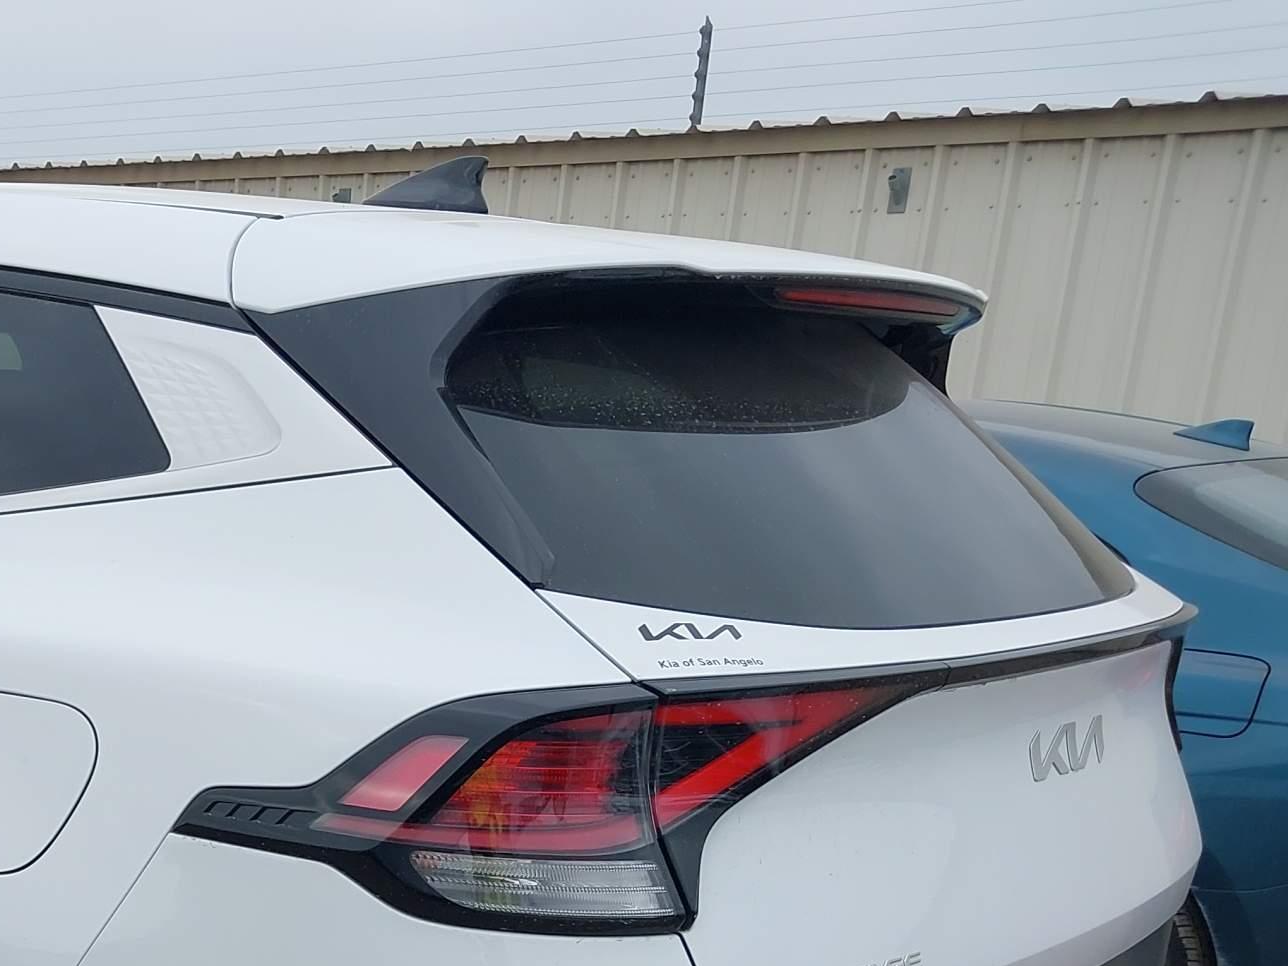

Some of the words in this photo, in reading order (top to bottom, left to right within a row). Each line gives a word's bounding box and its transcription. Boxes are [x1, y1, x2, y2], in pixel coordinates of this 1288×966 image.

[638, 622, 742, 641] KIA
[658, 660, 679, 669] Kia
[683, 658, 695, 667] of
[698, 657, 721, 667] San
[724, 657, 764, 668] Angelo
[1029, 714, 1105, 782] KIA
